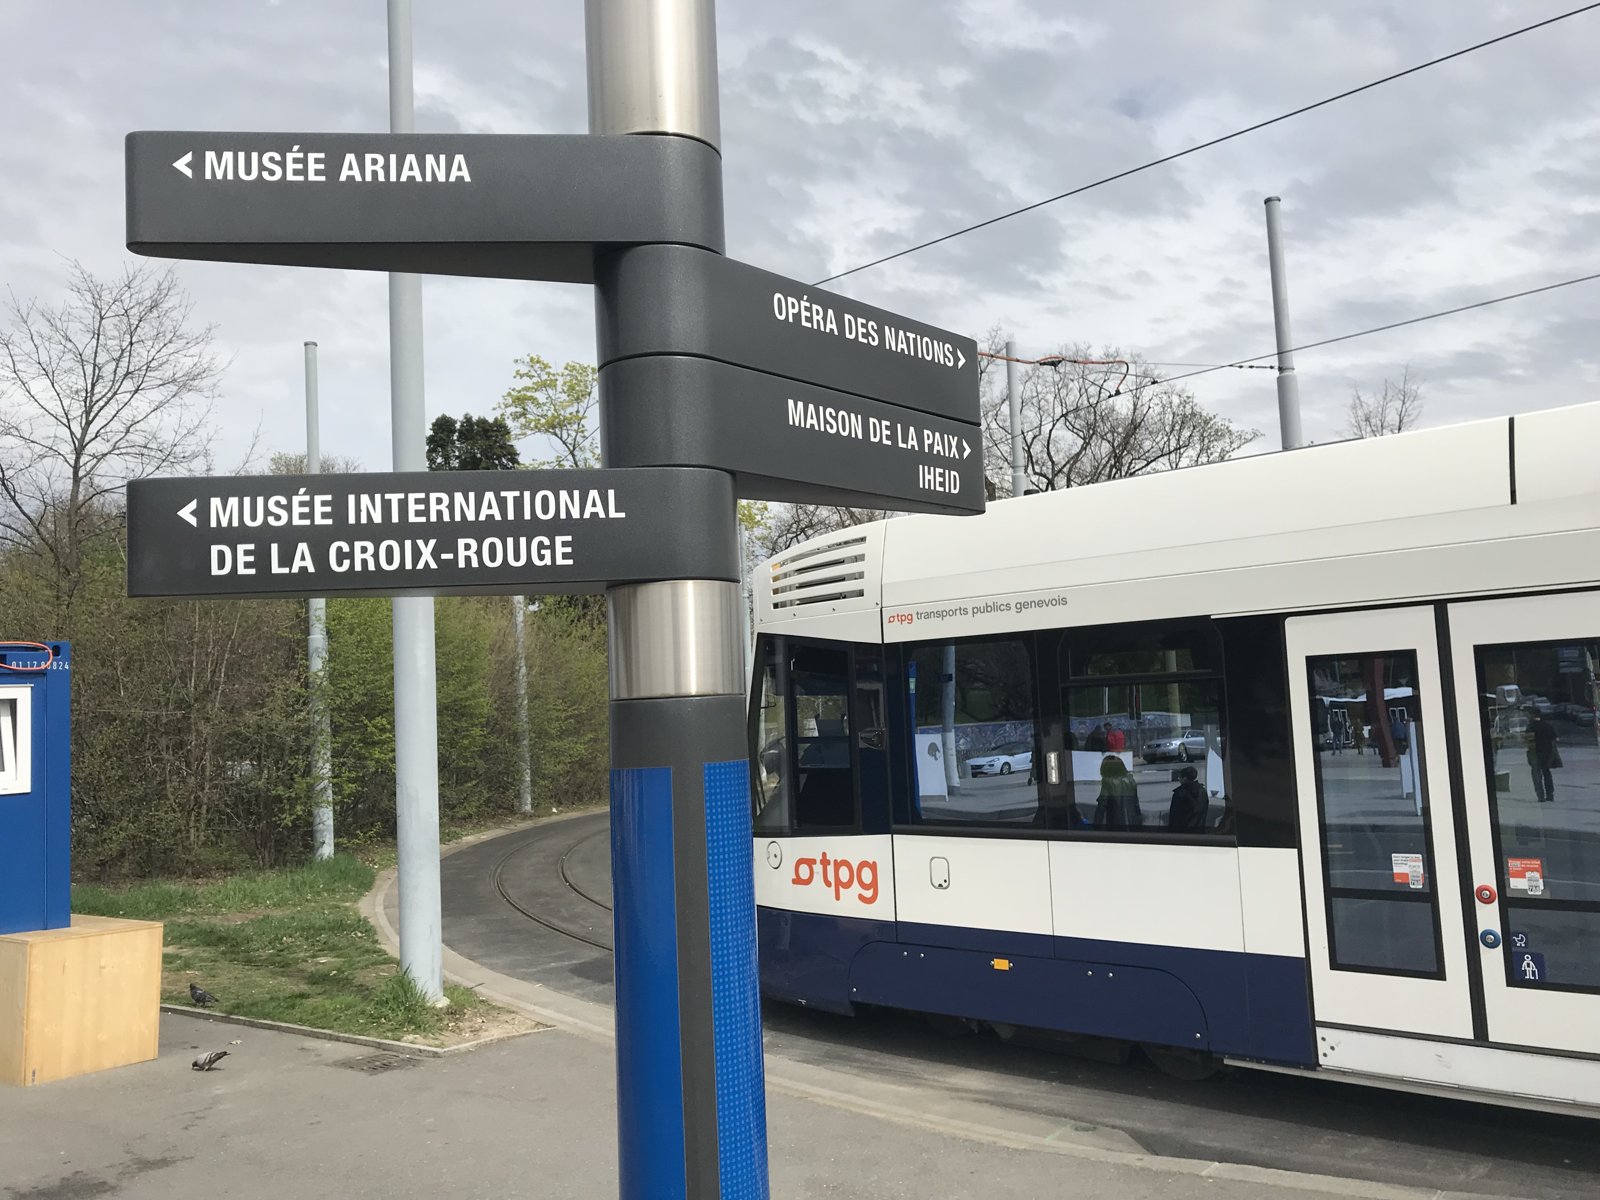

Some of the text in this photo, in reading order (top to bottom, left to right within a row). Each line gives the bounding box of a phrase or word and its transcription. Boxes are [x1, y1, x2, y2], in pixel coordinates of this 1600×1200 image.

[204, 145, 472, 183] MUSÉE ARIANA
[773, 292, 955, 367] OPÉRA DES NATIONS
[787, 398, 960, 460] MAISON DE LA PAIX
[918, 464, 960, 494] IHEID
[209, 487, 626, 528] MUSÉE INTERNATIONAL
[210, 535, 574, 576] DE LA CROIX-ROUGE
[915, 605, 969, 621] transports
[972, 601, 1012, 618] publics
[1014, 595, 1068, 614] genevois
